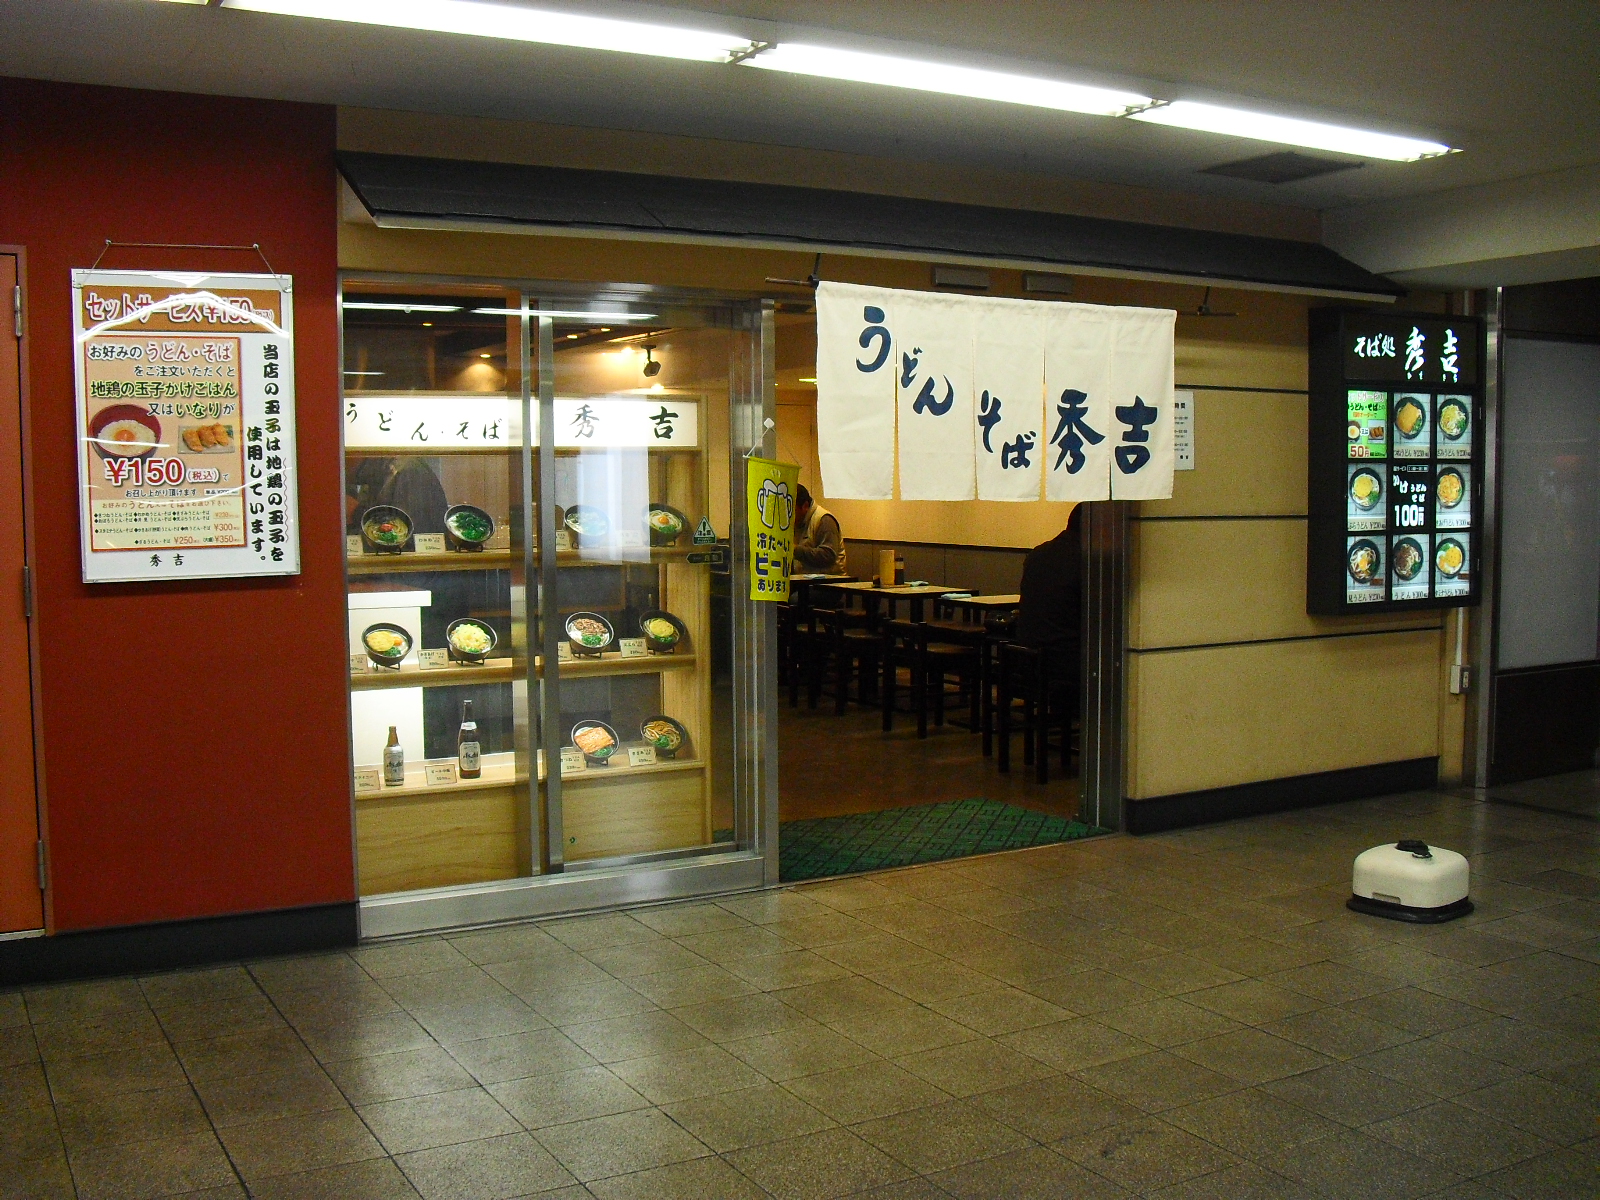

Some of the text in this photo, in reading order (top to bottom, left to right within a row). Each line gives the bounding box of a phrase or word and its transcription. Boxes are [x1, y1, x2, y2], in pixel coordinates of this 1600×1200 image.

[1354, 326, 1460, 374] そば処 秀吉
[134, 365, 236, 378] をご注文いただくと
[90, 380, 237, 399] 地鶏の玉子かけごはん
[856, 305, 1158, 475] うどん そば 秀吉
[147, 402, 236, 419] 又はいなりが
[569, 403, 678, 440] 秀吉
[263, 344, 286, 562] 当店の玉子は地鶏の玉子を
[104, 457, 186, 486] ¥150
[186, 468, 220, 484] (税込)
[125, 488, 197, 498] お召し上がり頂けます
[247, 426, 266, 561] 使用しています。
[1394, 504, 1425, 527] 100円
[150, 553, 185, 568] 秀吉
[755, 552, 790, 578] ビール
